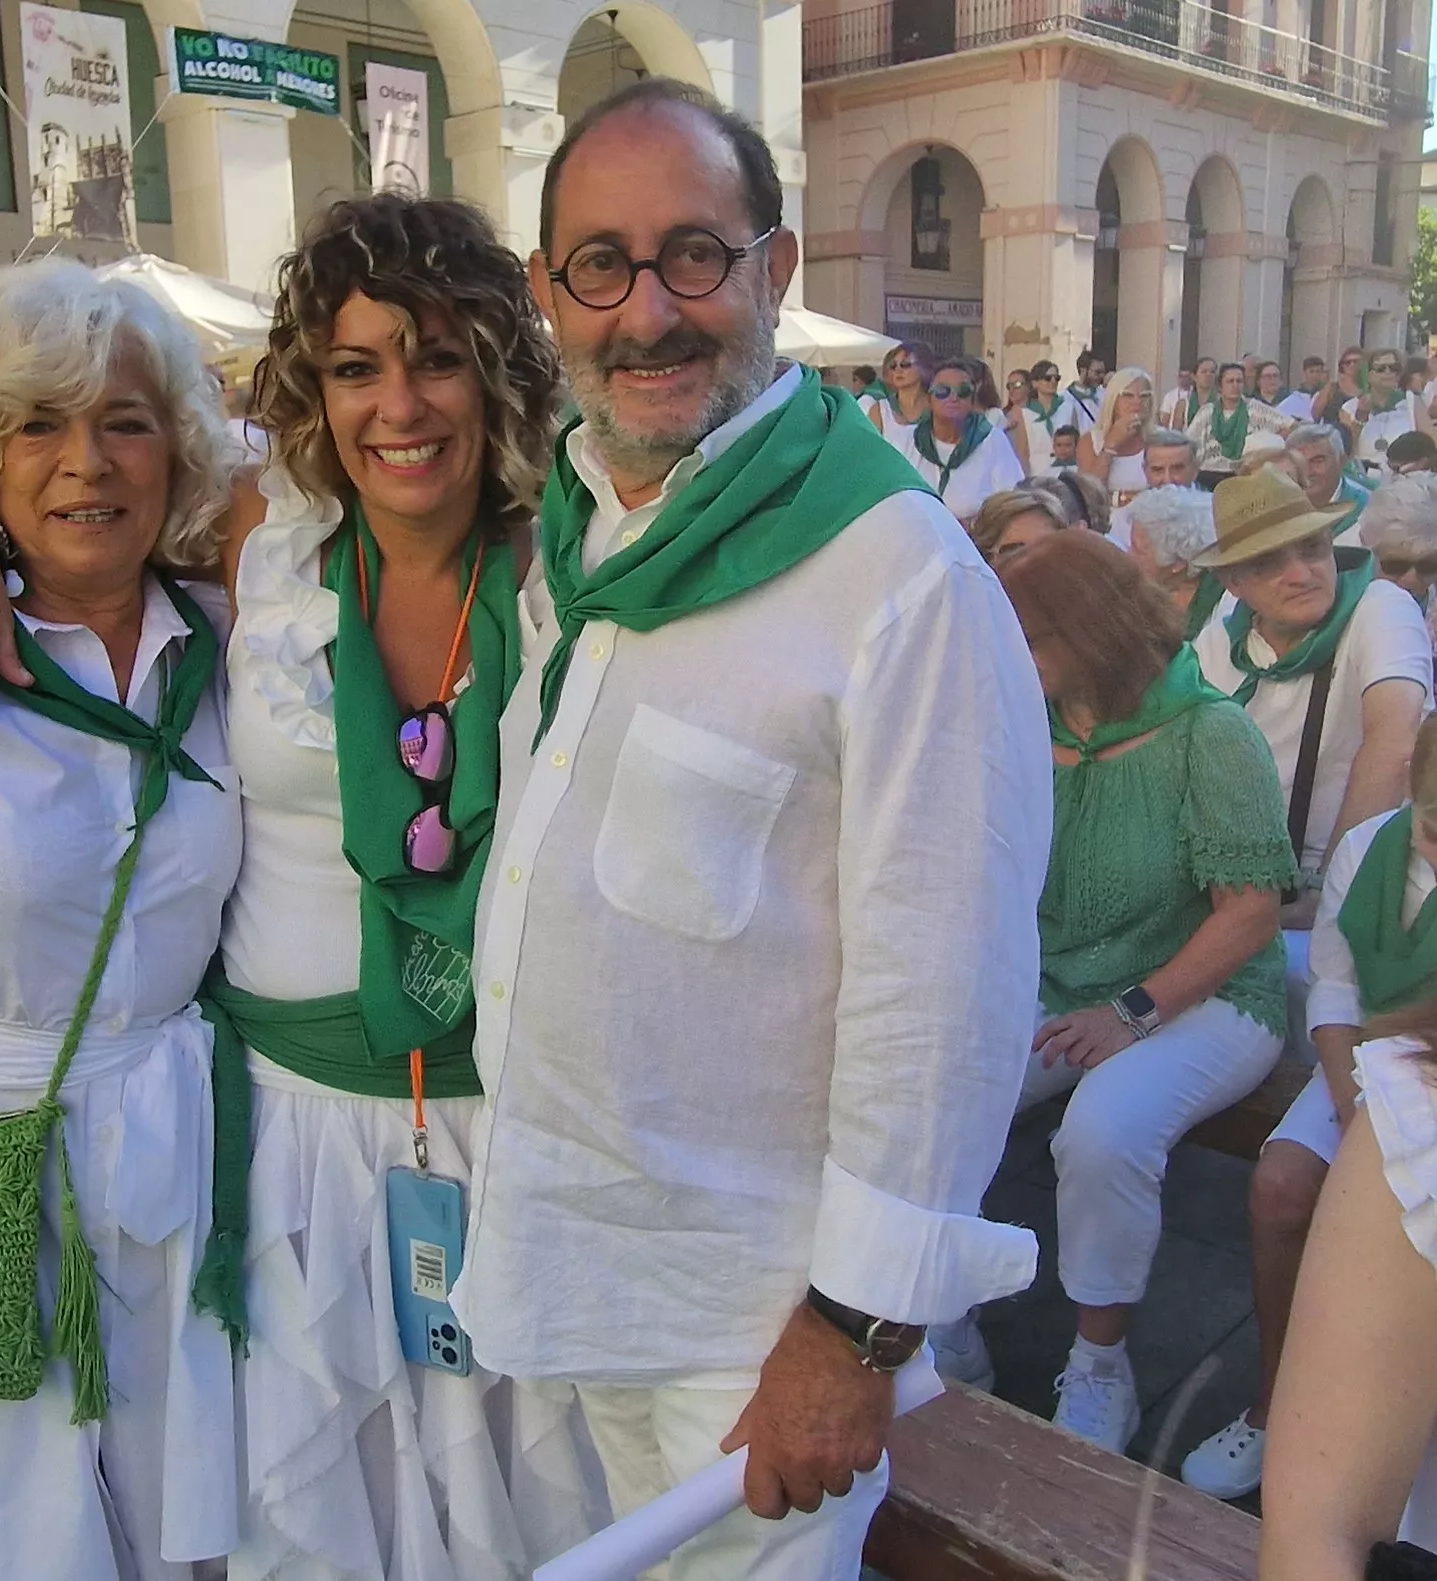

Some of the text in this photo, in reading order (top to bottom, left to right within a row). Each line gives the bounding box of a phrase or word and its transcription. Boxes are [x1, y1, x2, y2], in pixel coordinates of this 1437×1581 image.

[181, 35, 212, 58] YO
[217, 37, 249, 60] NO
[71, 57, 120, 88] HUESCA
[184, 60, 262, 84] ALCOHOL
